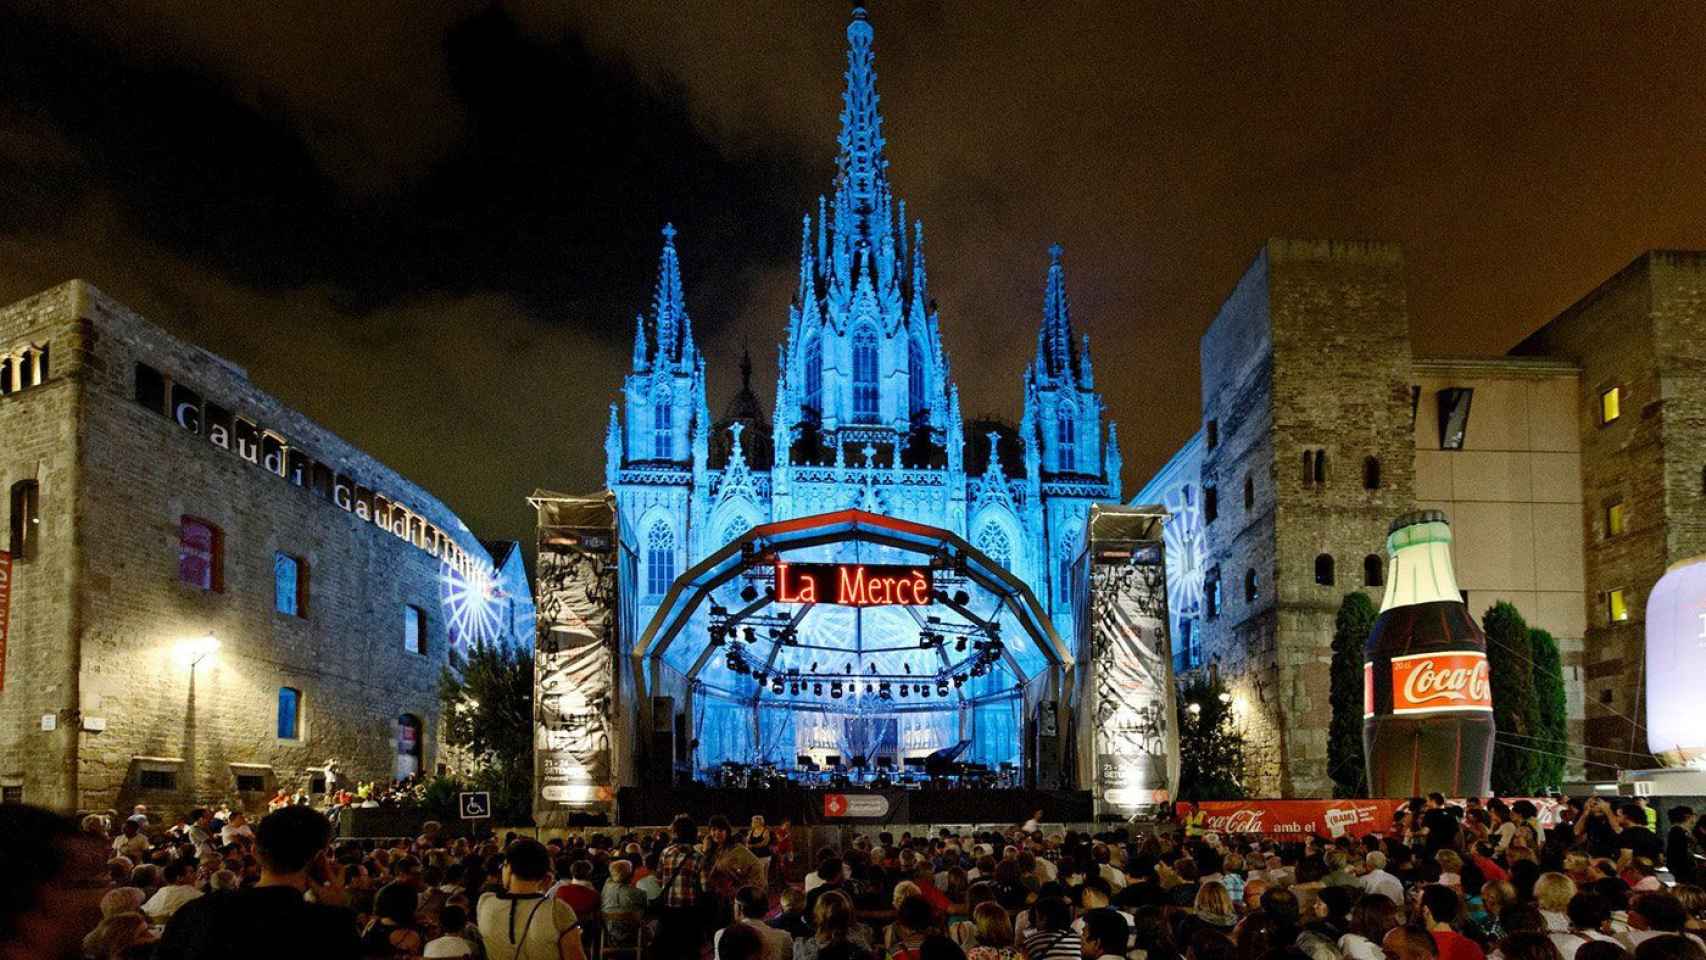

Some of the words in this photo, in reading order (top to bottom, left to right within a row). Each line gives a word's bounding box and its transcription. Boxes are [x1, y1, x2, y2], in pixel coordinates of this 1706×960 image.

[777, 564, 816, 602] La
[838, 566, 929, 605] Mercè
[1273, 821, 1301, 833] amb
[1304, 821, 1316, 833] el
